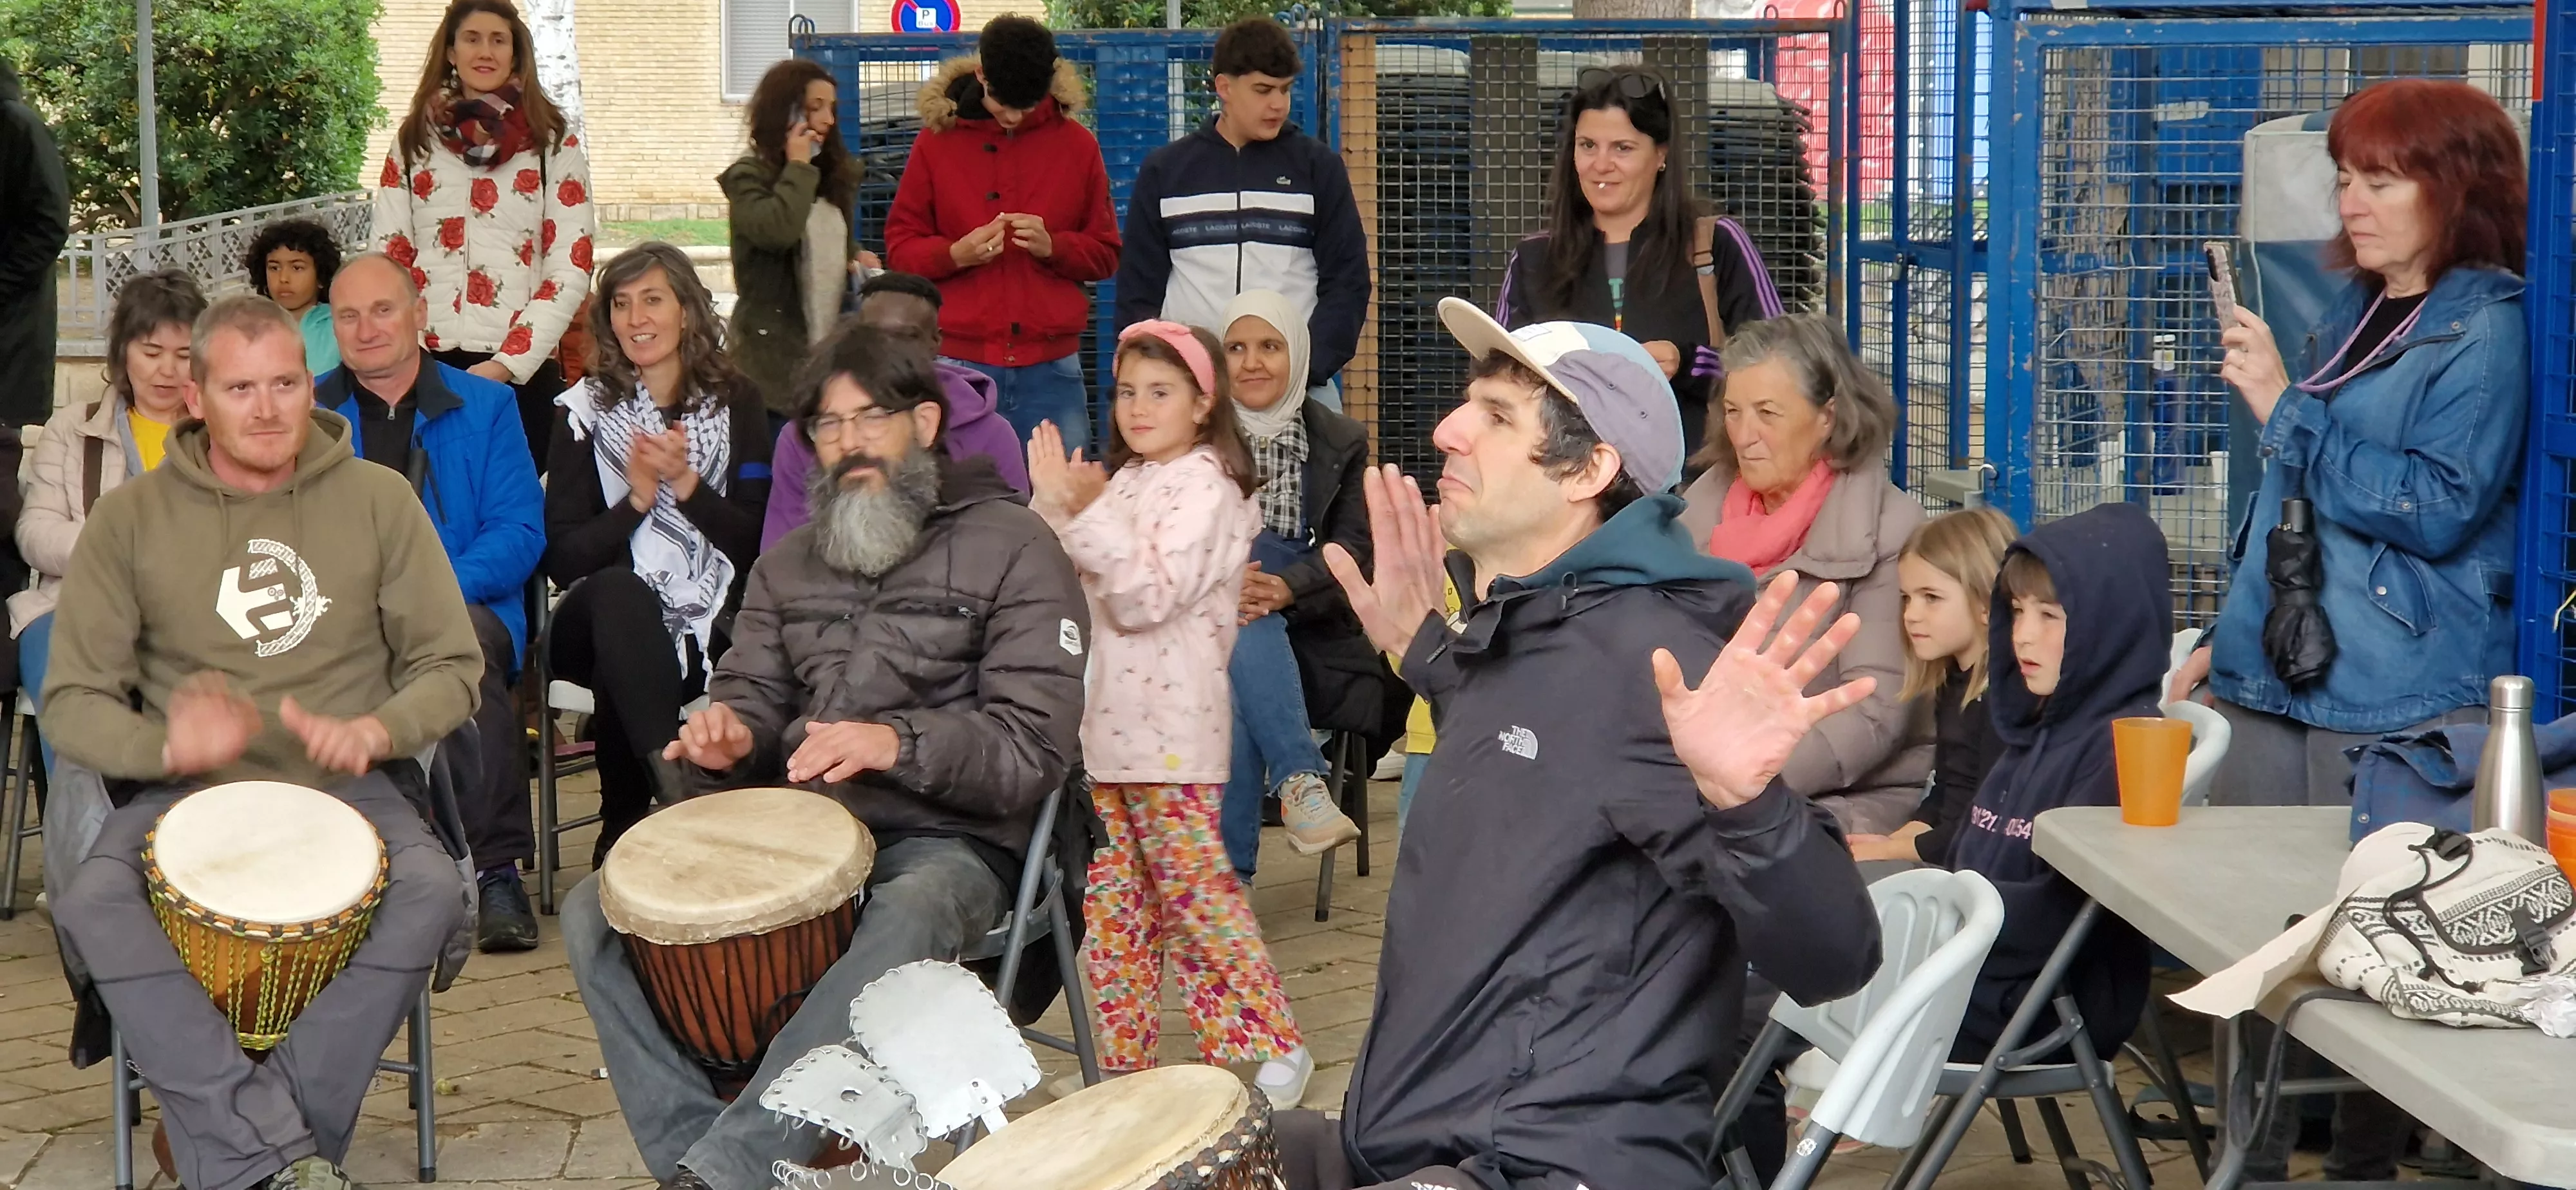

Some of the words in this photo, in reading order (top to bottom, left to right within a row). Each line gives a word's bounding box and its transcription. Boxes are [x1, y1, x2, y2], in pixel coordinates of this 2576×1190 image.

[922, 10, 930, 20] P
[1497, 730, 1523, 746] NORTH
[1511, 725, 1526, 738] THE
[1502, 742, 1524, 755] FACE
